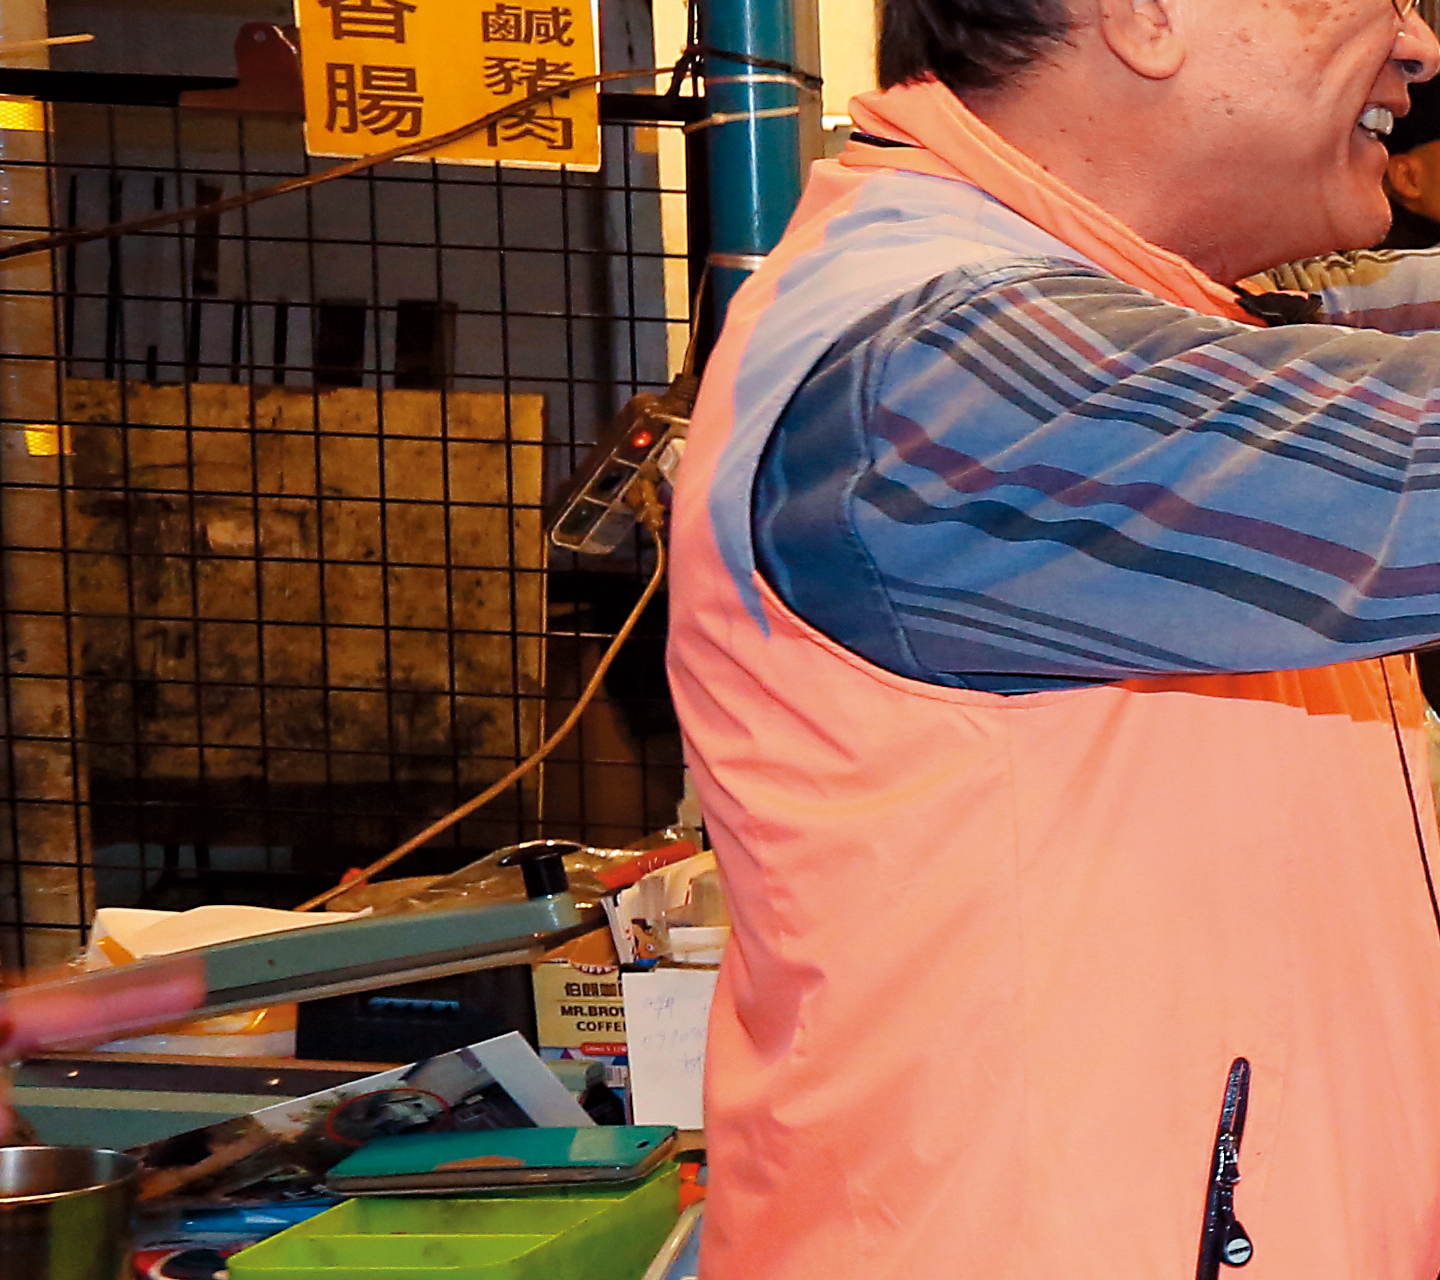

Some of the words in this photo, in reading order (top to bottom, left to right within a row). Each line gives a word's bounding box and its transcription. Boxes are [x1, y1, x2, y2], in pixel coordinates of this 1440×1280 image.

[564, 981, 623, 998] 伯朗咖
[560, 1005, 626, 1018] MR.BRO
